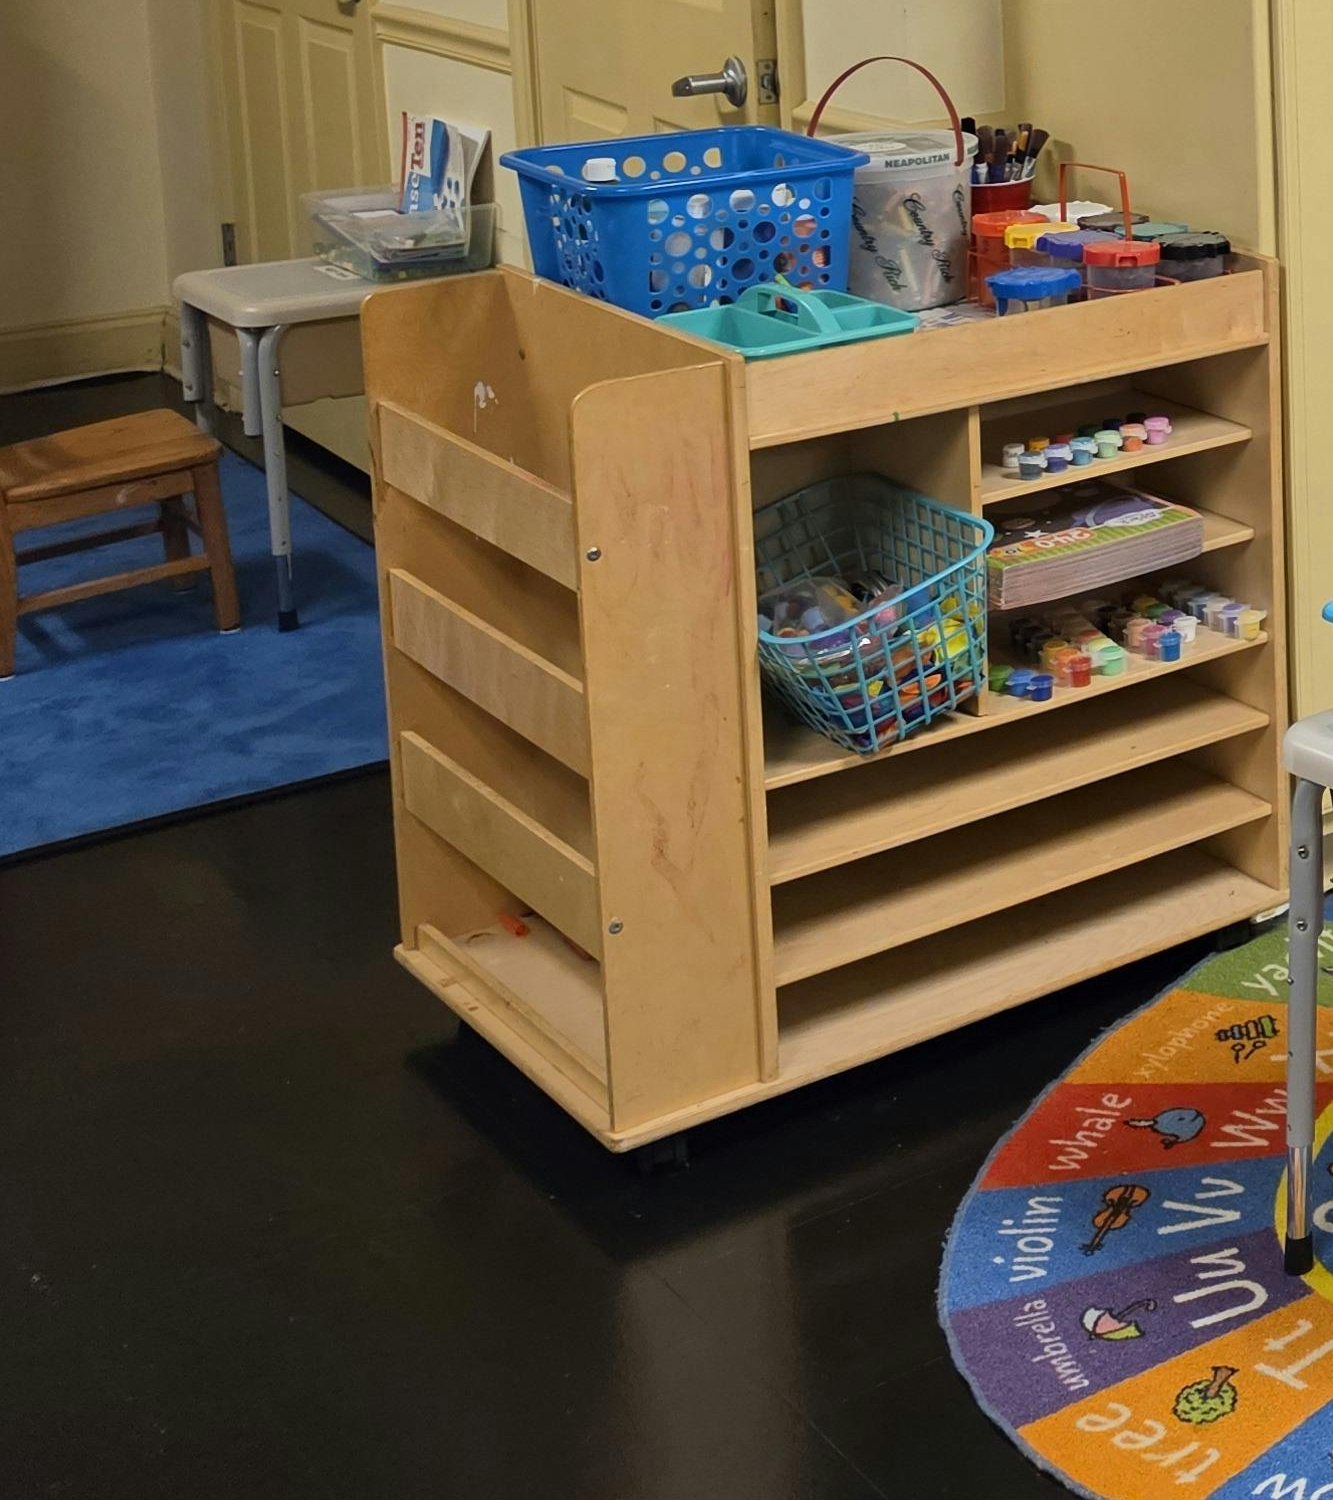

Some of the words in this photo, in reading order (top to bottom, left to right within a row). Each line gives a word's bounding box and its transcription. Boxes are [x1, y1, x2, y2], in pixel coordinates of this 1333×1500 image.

[884, 153, 950, 169] NEAPOLITAN
[875, 256, 907, 292] Rich
[903, 192, 935, 246] Country
[932, 249, 955, 284] Rich
[1134, 1002, 1236, 1079] xylophone
[1048, 1091, 1134, 1171] whale
[991, 1196, 1064, 1283] violin
[1014, 1299, 1090, 1392] umbrella
[1075, 1402, 1222, 1485] tree
